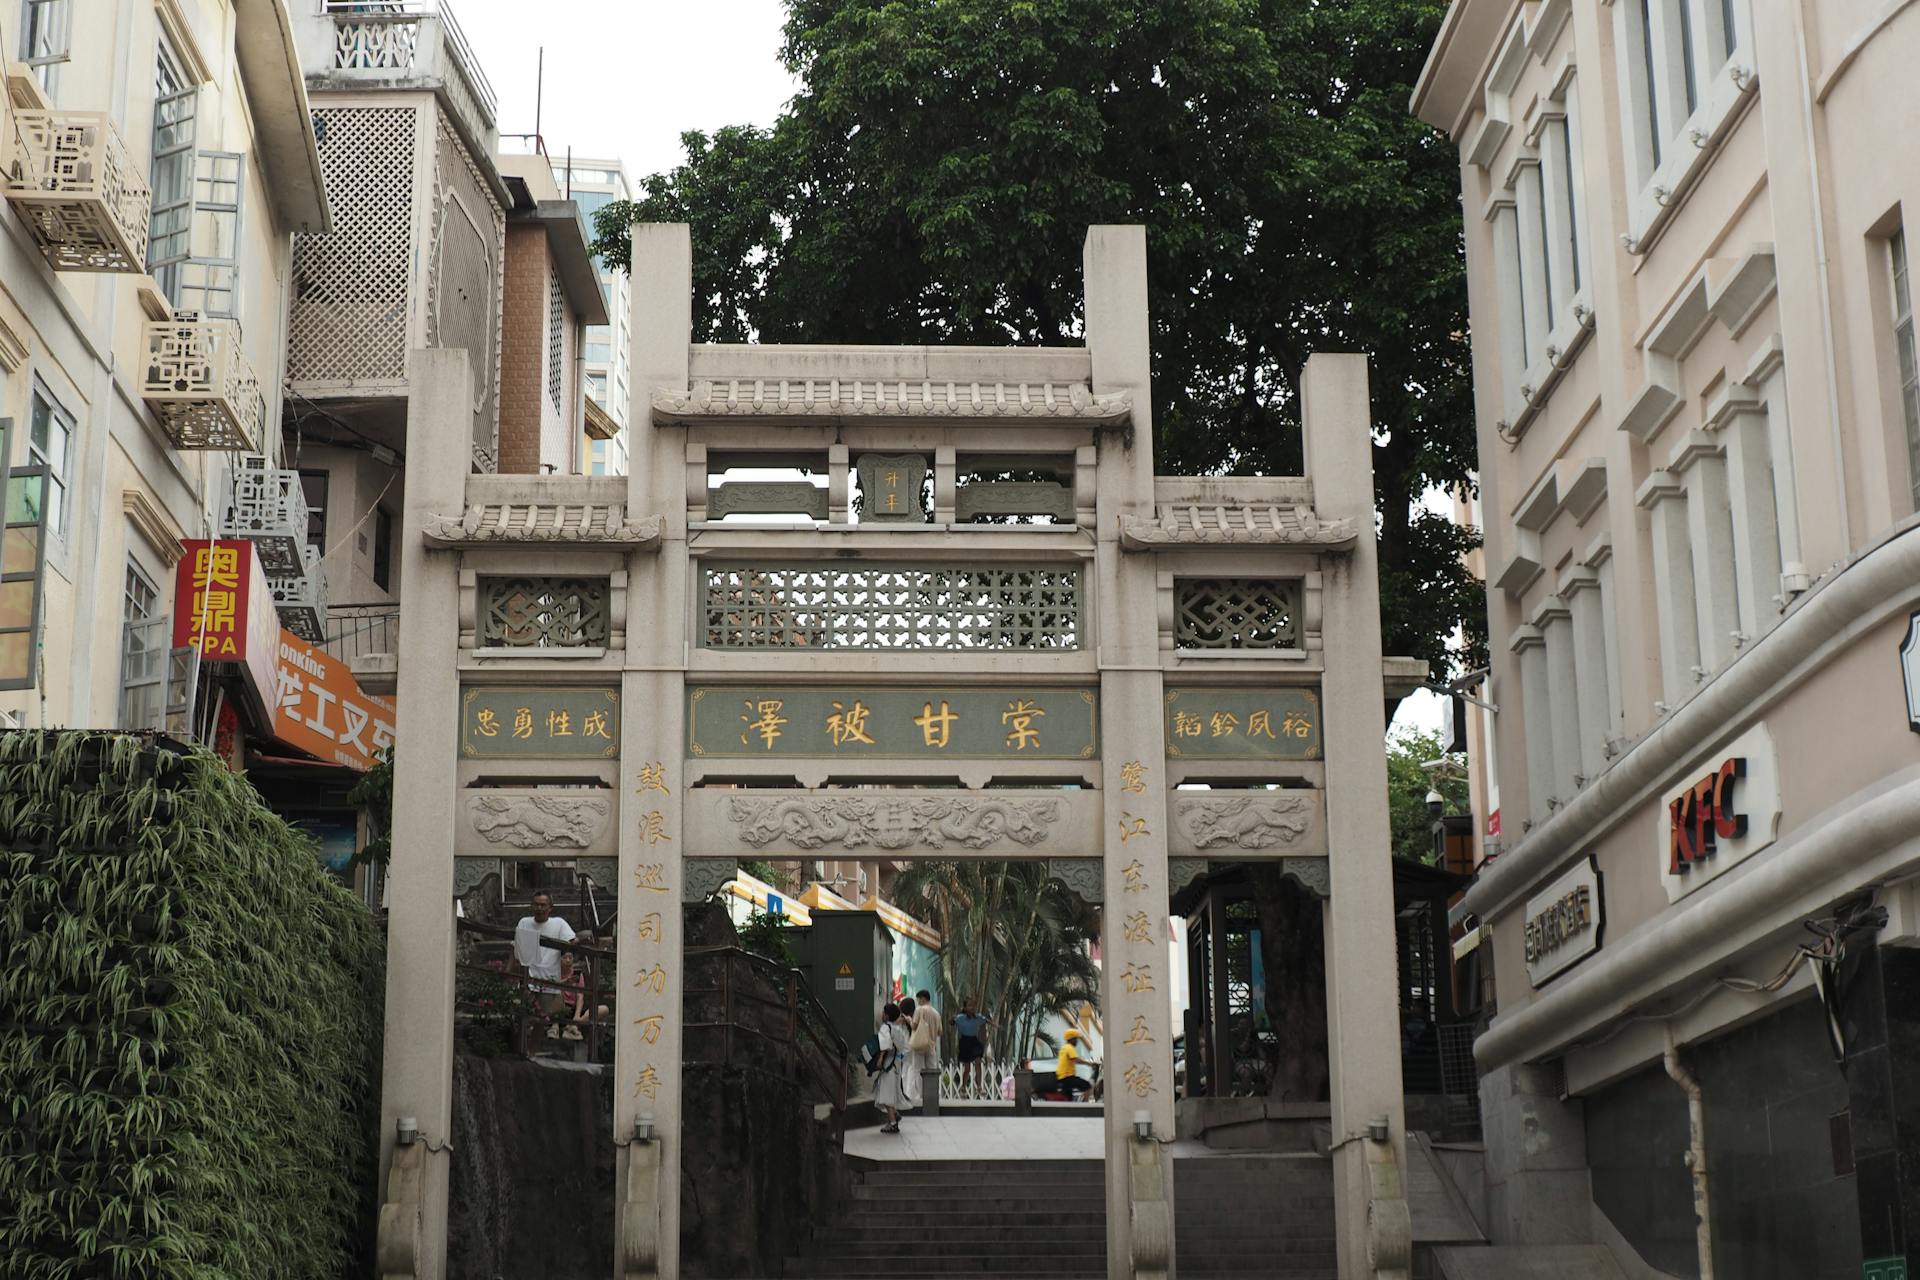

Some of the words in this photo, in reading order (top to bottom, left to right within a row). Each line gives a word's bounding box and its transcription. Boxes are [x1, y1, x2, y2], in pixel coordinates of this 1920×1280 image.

[191, 545, 239, 632] 奥鼎
[473, 707, 612, 740] 忠勇性成
[739, 698, 1046, 750] 澤被甘棠
[1669, 757, 1748, 875] KFC
